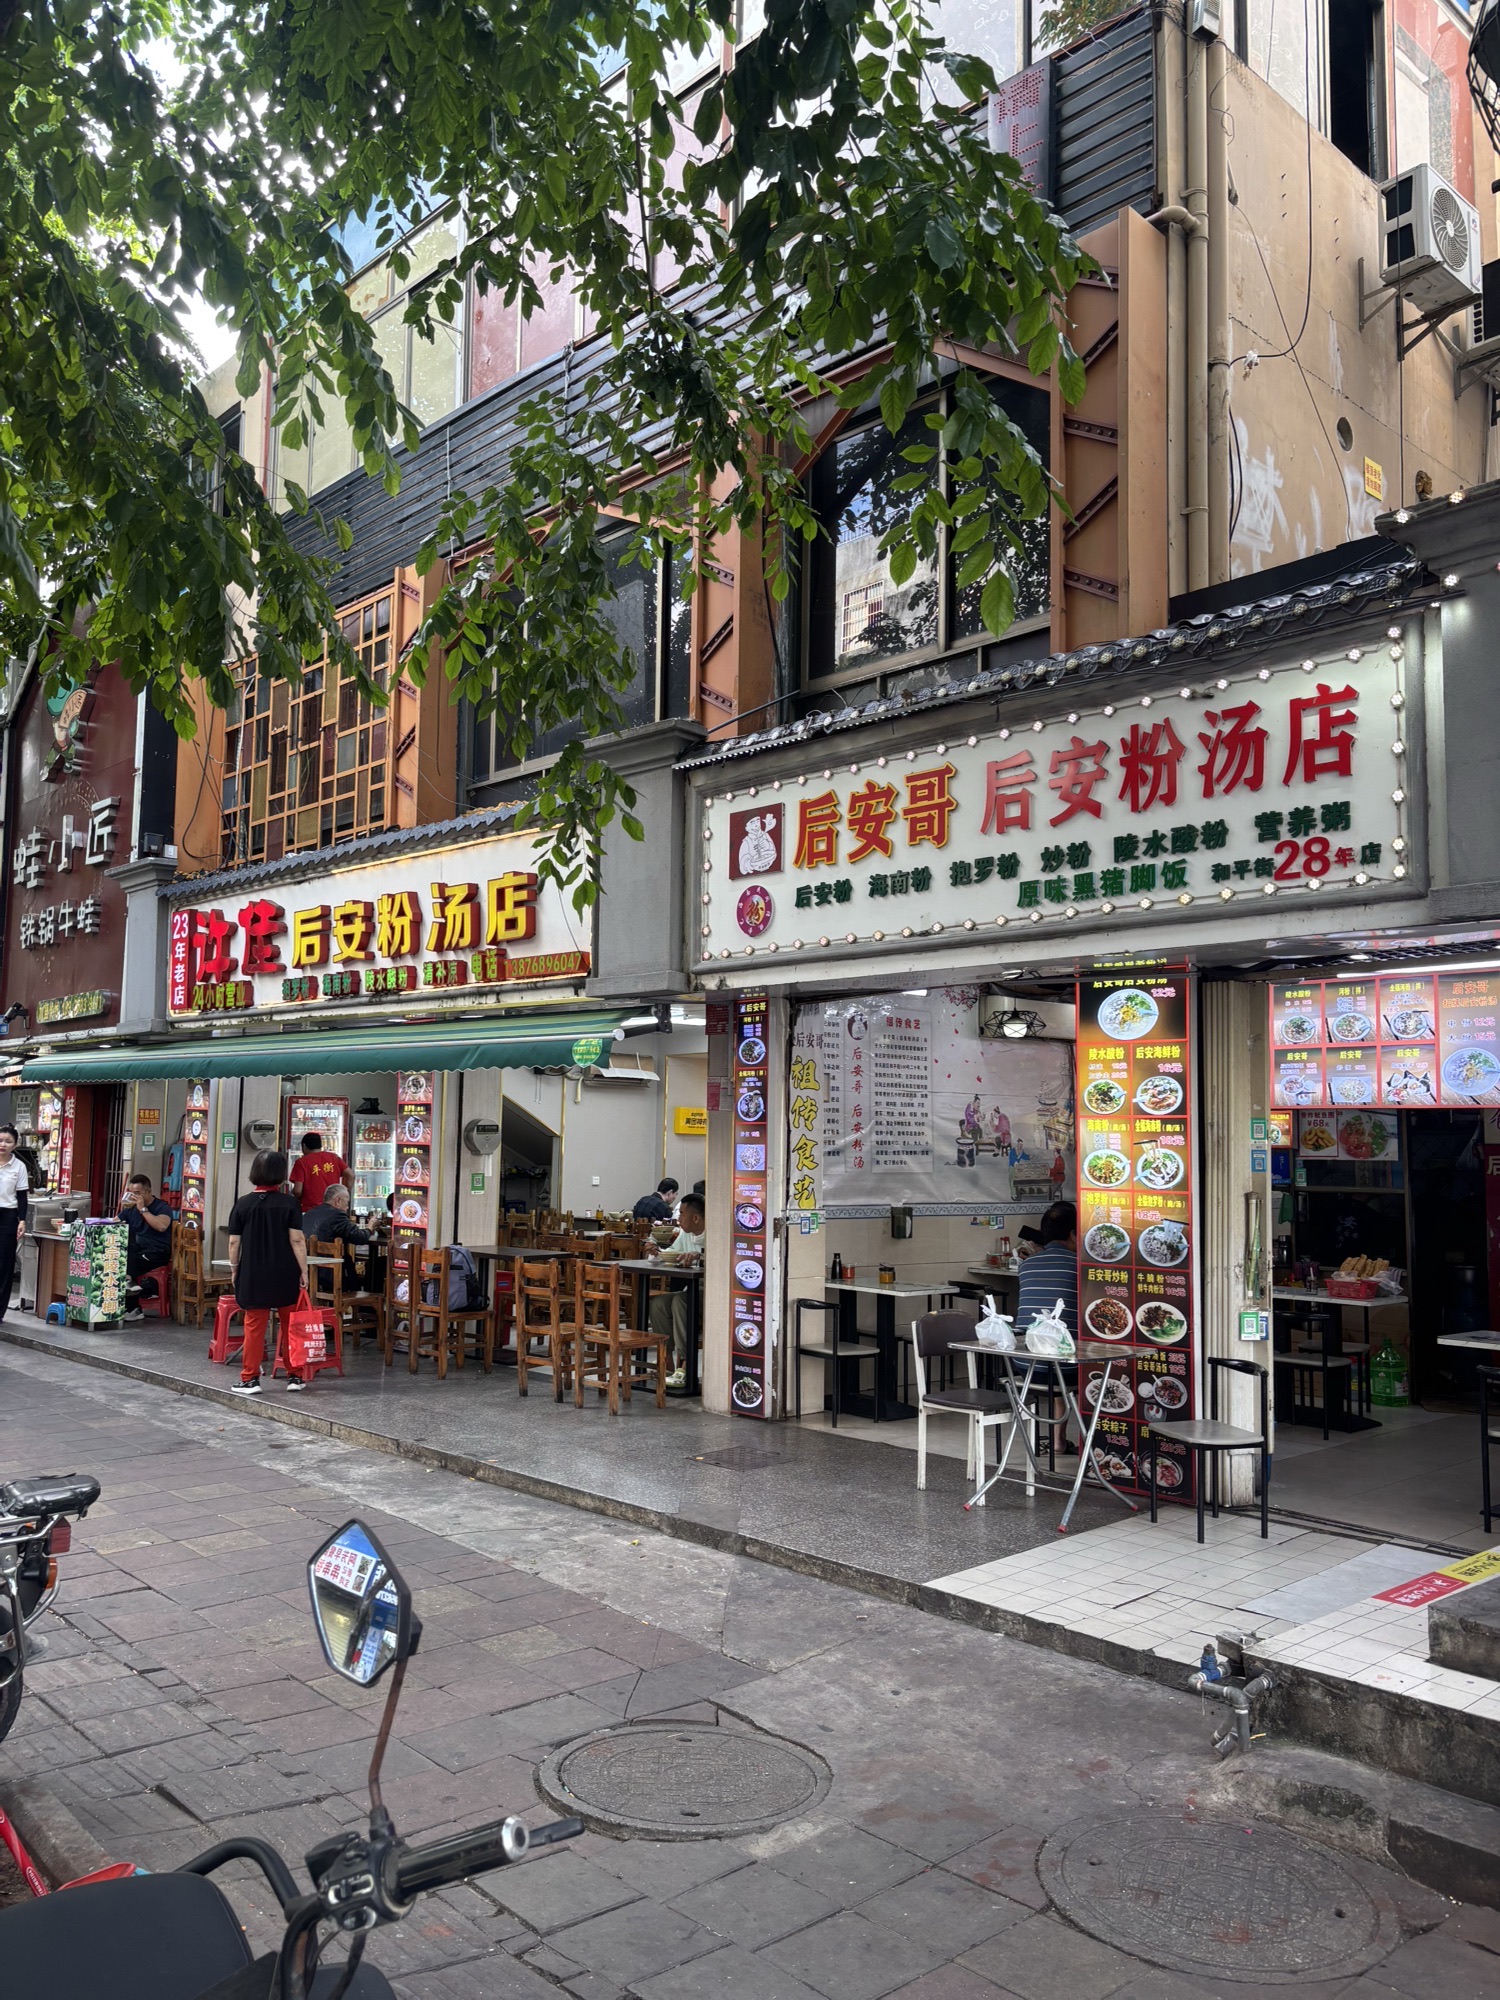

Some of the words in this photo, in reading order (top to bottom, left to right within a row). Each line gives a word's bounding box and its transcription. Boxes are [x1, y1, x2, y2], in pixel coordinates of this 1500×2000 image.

[793, 761, 958, 868] 后安哥
[980, 683, 1359, 834] 后安粉汤店
[13, 797, 121, 889] 蛙小匠
[795, 878, 854, 908] 后安粉
[868, 866, 931, 897] 海南粉
[949, 852, 1020, 886] 抱罗粉
[1040, 840, 1092, 873] 炒粉
[1113, 818, 1229, 863] 陵水酸粉
[1254, 800, 1351, 843] 营养粥
[1017, 858, 1188, 908] 原味黑猪脚饭
[19, 894, 100, 950] 铁锅牛蛙
[292, 871, 538, 967] 后安粉汤店
[173, 913, 189, 1005] 23年老店
[322, 971, 351, 995] 海南粉
[365, 966, 408, 992] 陵水酸粉
[423, 960, 458, 985] 清补凉
[471, 949, 497, 981] 电话
[504, 952, 581, 978] 13876896047
[795, 1033, 824, 1049] 后安哥
[851, 1047, 864, 1095] 后安哥
[1089, 1047, 1125, 1060] 陵水酸粉
[1136, 1046, 1181, 1059] 后安海鲜粉
[790, 1055, 821, 1209] 祖传食艺
[851, 1104, 865, 1169] 后安粉汤
[1137, 1211, 1160, 1220] 18元
[102, 1232, 121, 1314] 正宗陵水槟榔
[1087, 1268, 1129, 1284] 后安哥炒粉
